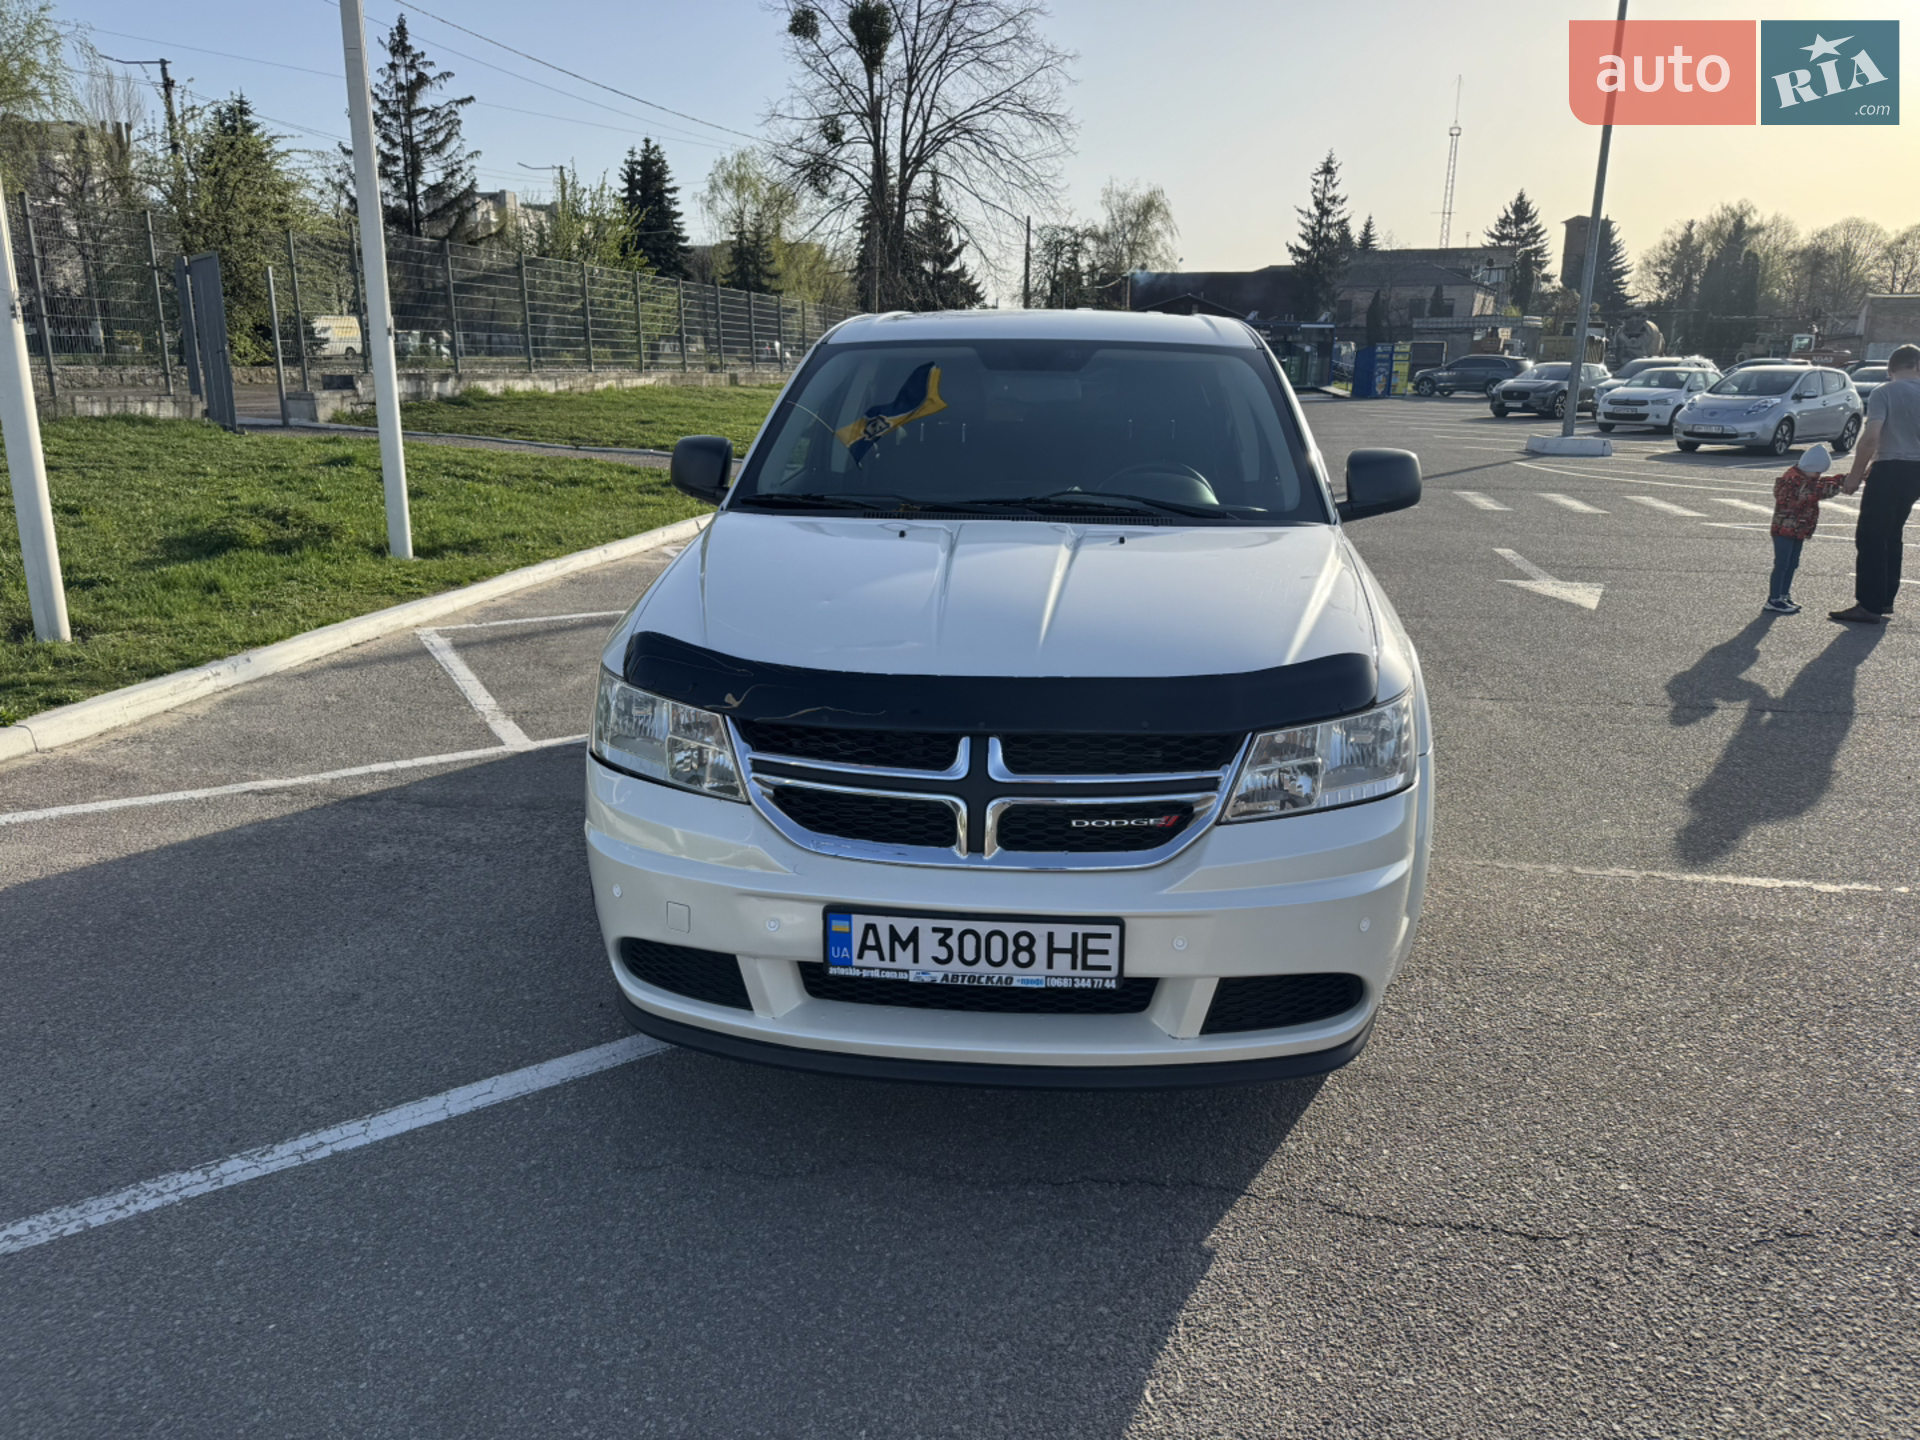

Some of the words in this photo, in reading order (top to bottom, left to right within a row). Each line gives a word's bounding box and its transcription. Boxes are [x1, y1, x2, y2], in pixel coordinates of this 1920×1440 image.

[1071, 818, 1167, 828] DODGE
[831, 946, 851, 960] UA
[856, 923, 920, 964] AM
[931, 927, 1037, 969] 3008
[1046, 931, 1113, 972] HE
[1046, 977, 1072, 988] (068)
[1073, 978, 1092, 988] 344
[1103, 979, 1116, 989] 44
